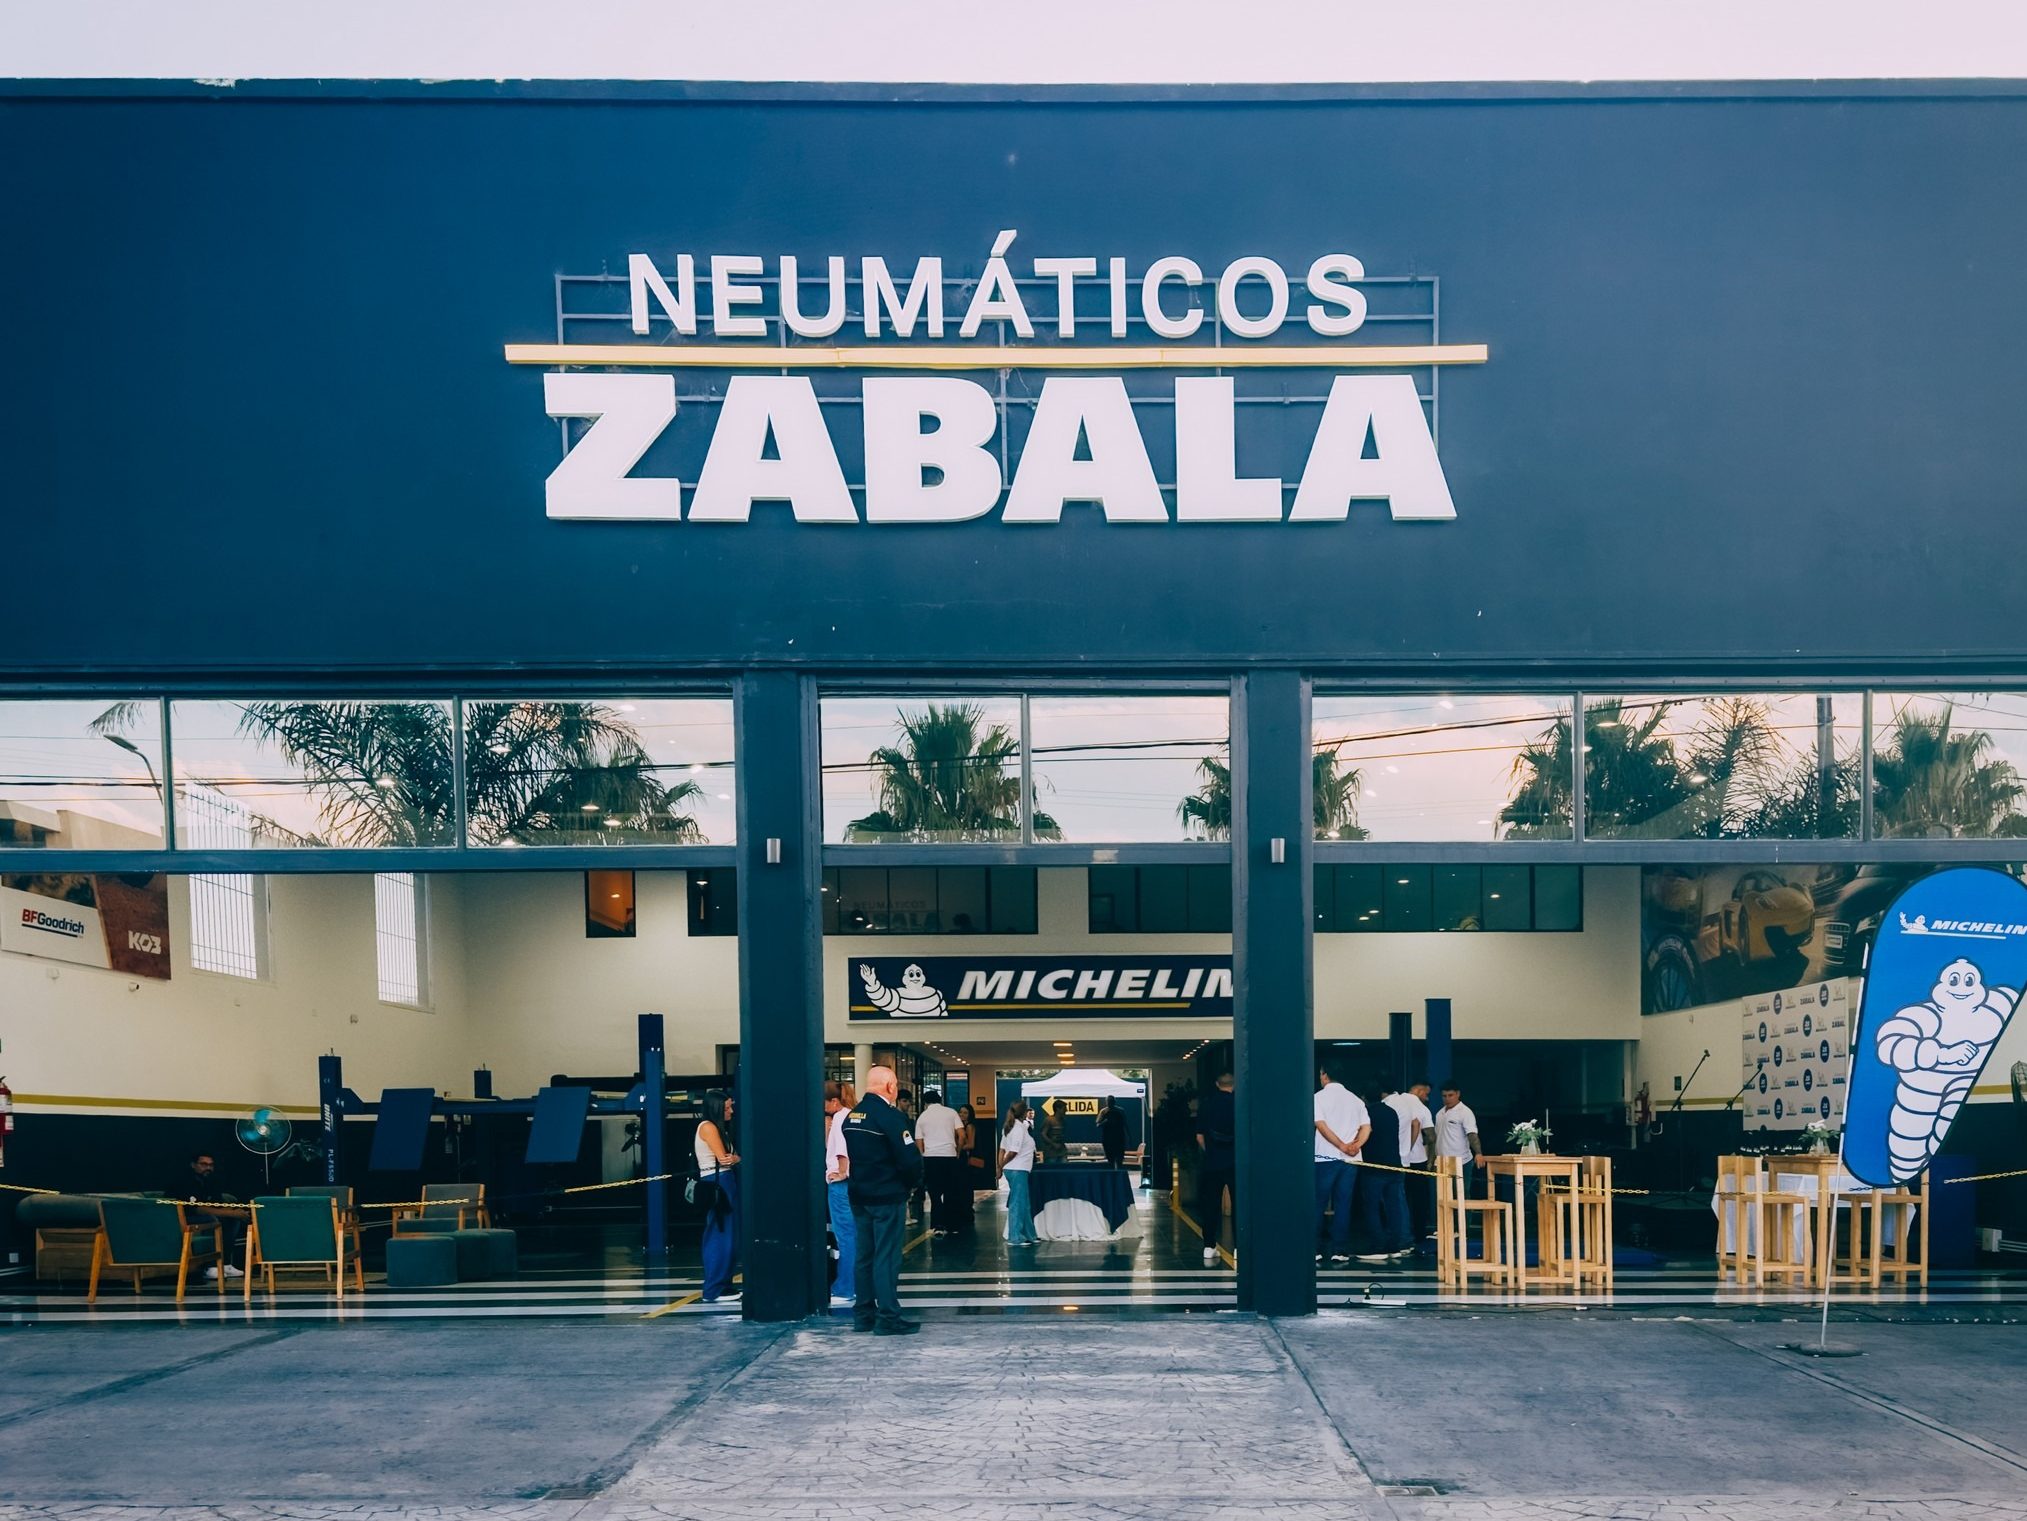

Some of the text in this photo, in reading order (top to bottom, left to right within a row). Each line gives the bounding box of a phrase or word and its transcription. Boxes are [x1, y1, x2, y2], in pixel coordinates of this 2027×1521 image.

[627, 230, 1367, 339] NEUMÁTICOS
[544, 373, 1458, 523] ZABALA
[22, 908, 84, 934] BFGoodrich
[1931, 920, 2027, 935] MICHELIN
[1067, 1101, 1095, 1113] LIDA
